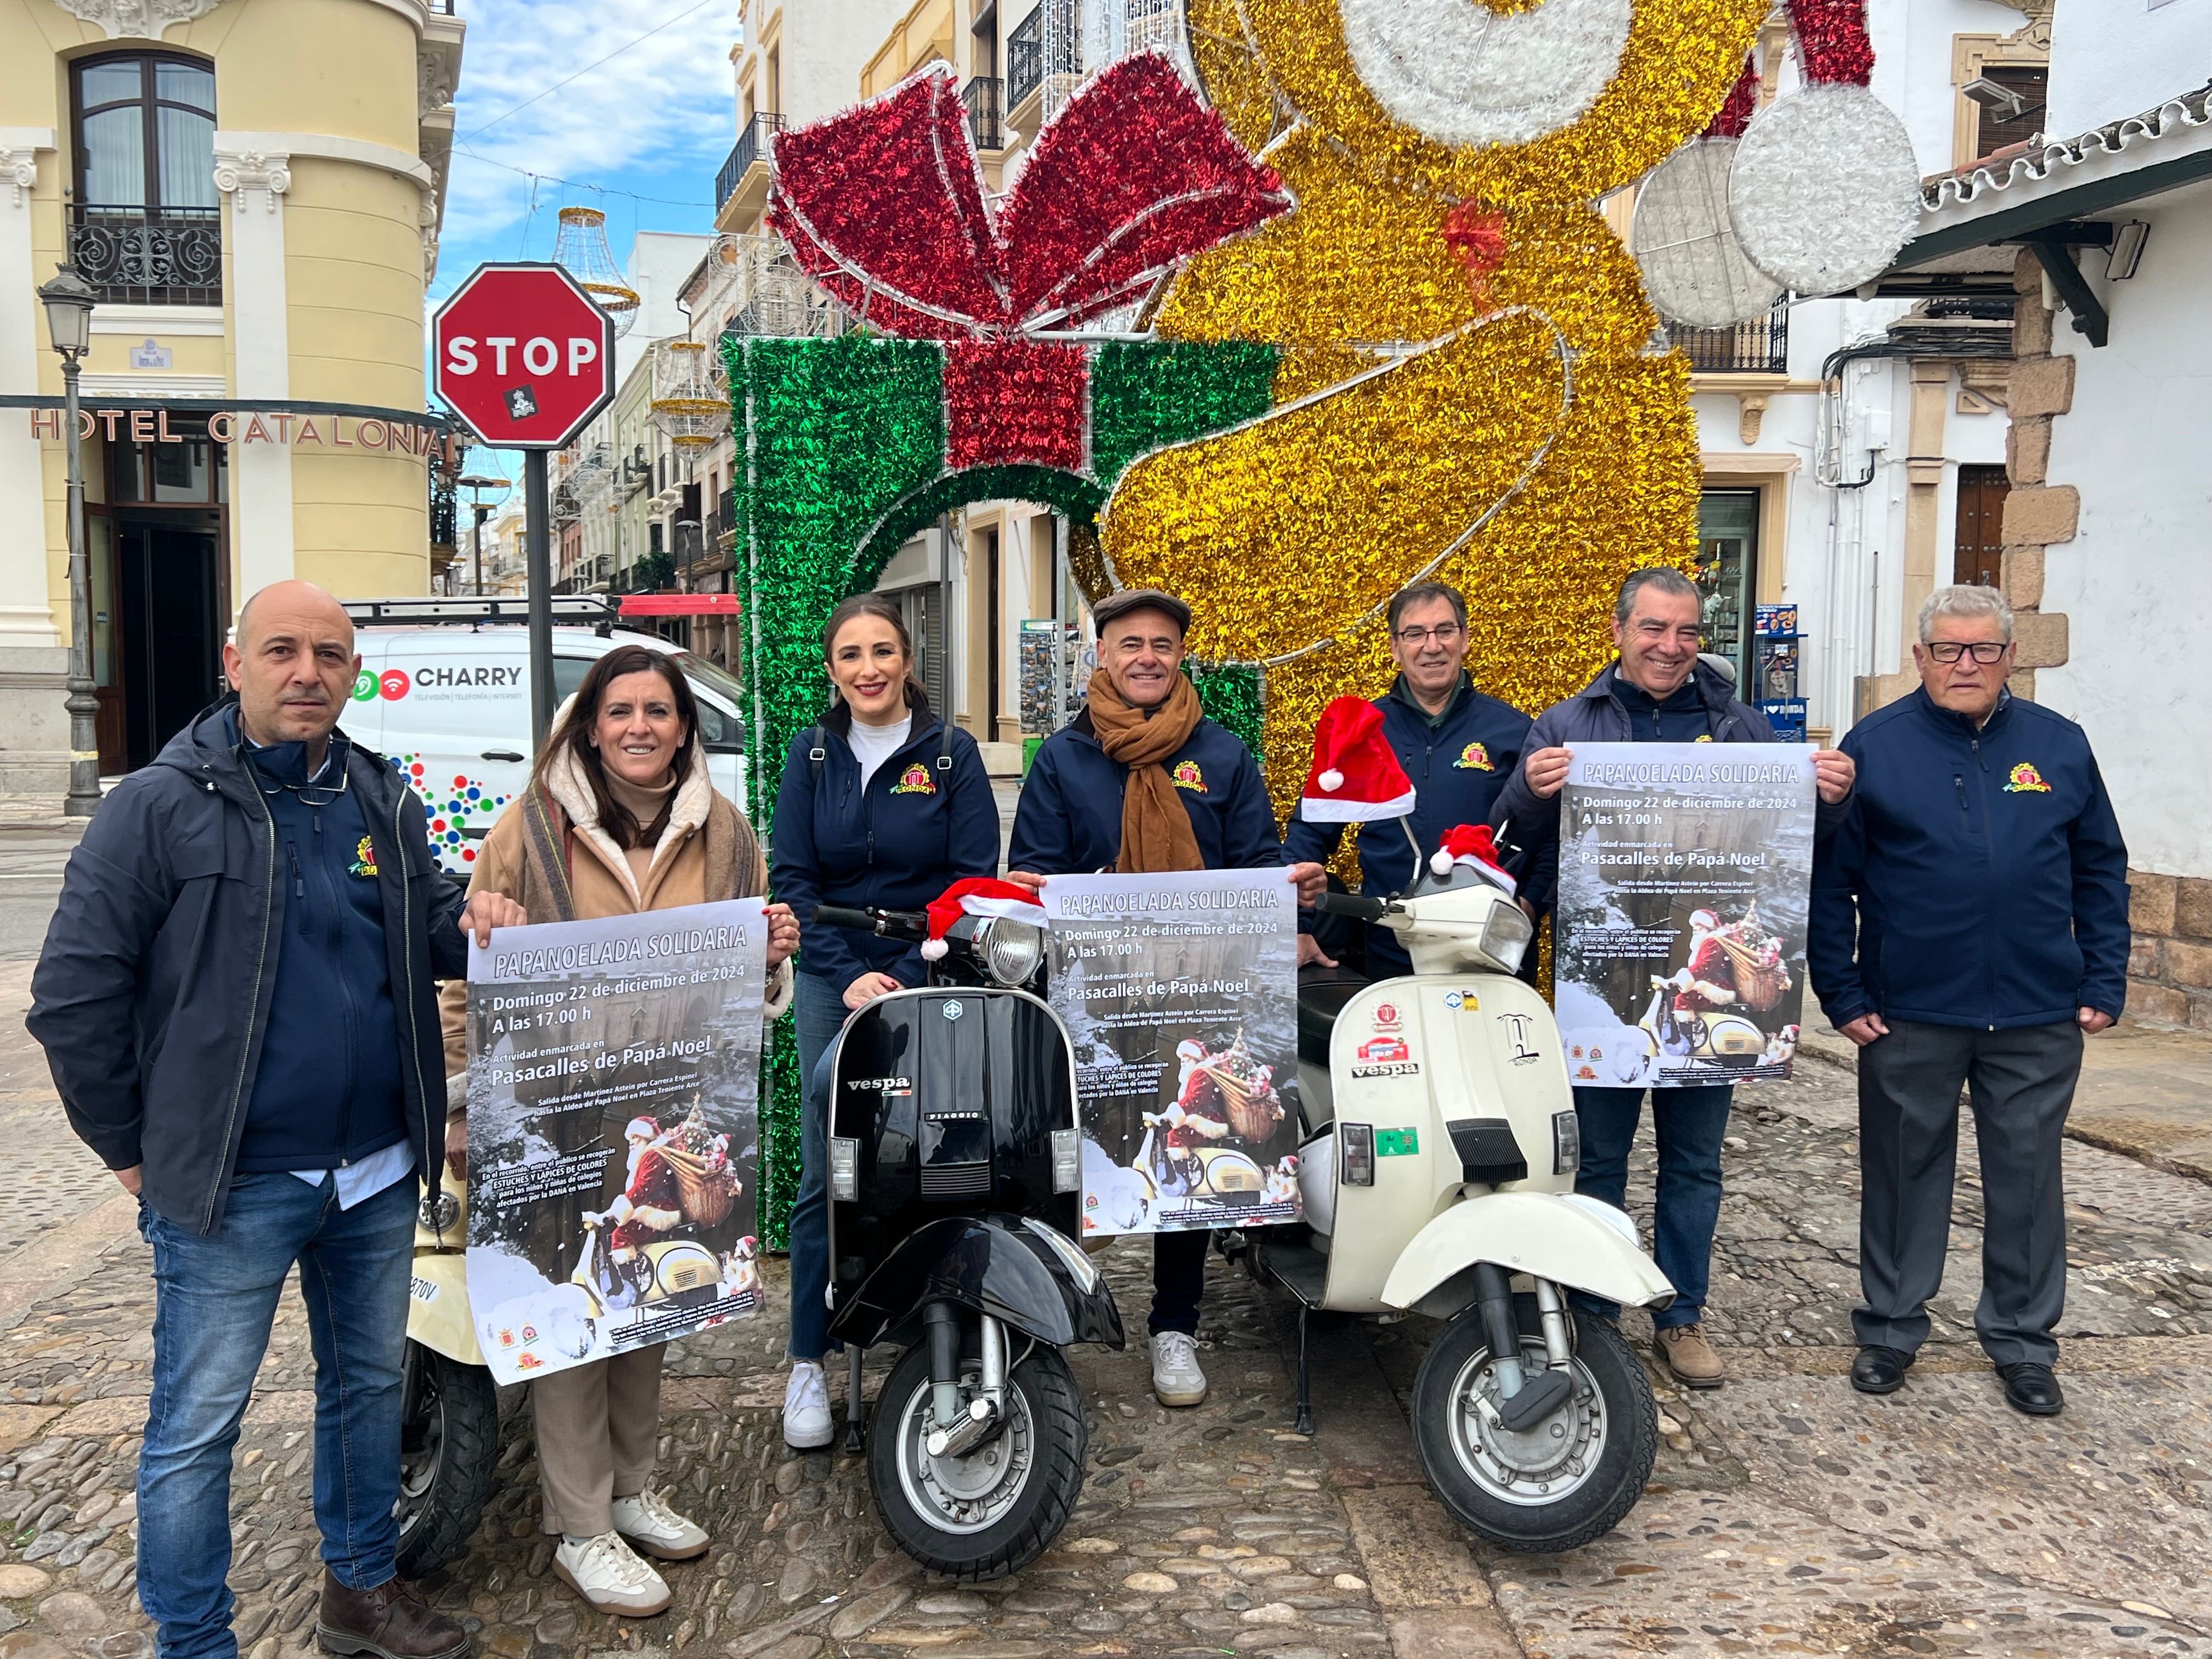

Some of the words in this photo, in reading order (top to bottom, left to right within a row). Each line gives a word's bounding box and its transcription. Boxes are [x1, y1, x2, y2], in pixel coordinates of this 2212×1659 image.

[446, 336, 597, 376] STOP
[30, 408, 183, 443] HOTEL
[208, 411, 444, 459] CATALONIA
[415, 667, 522, 686] CHARRY
[414, 693, 450, 701] TELEVISIÓN
[1779, 705, 1804, 714] RONDA
[1583, 764, 1705, 782] PAPANOELADA
[1709, 764, 1799, 783] SOLIDARIA
[1583, 796, 1640, 810] Domingo
[1644, 797, 1658, 808] 22
[1663, 797, 1678, 808] de
[1681, 796, 1743, 808] diciembre
[1747, 797, 1763, 808] de
[1766, 798, 1797, 809] 2024
[1582, 814, 1592, 824] A
[1595, 812, 1612, 824] las
[1617, 814, 1650, 825] 17.00
[1655, 812, 1662, 824] h
[1581, 851, 1660, 865] Pasacalles
[1664, 851, 1683, 865] de
[1688, 851, 1724, 868] Papá
[1730, 852, 1765, 865] Noel
[1060, 891, 1184, 915] PAPANOELADA
[1188, 888, 1279, 910] SOLIDARIA
[1065, 928, 1120, 941] Domingo
[1123, 926, 1137, 937] 22
[1142, 924, 1156, 936] de
[1161, 921, 1223, 936] diciembre
[1227, 922, 1243, 934] de
[1246, 922, 1278, 934] 2024
[495, 938, 642, 978] PAPANOELADA
[647, 925, 747, 958] SOLIDARIA
[1067, 947, 1076, 958] A
[1079, 945, 1096, 957] las
[1099, 944, 1132, 956] 17.00
[1135, 942, 1142, 953] h
[1068, 973, 1103, 983] Actividad
[1103, 970, 1144, 980] enmarcada
[493, 991, 565, 1011] Domingo
[569, 985, 586, 1000] 22
[592, 982, 610, 997] de
[614, 970, 686, 994] diciembre
[690, 969, 708, 983] de
[712, 964, 744, 980] 2024
[1066, 982, 1144, 1001] Pasacalles
[1147, 980, 1165, 995] de
[1171, 978, 1207, 997] Papá
[1214, 978, 1248, 993] Noel
[492, 1019, 504, 1034] A
[509, 1016, 531, 1031] las
[536, 1008, 577, 1026] 17.00
[582, 1005, 590, 1020] h
[492, 1048, 537, 1064] Actividad
[540, 1039, 590, 1056] enmarcada
[490, 1054, 589, 1088] Pasacalles
[594, 1050, 617, 1069] de
[623, 1042, 665, 1065] Papá
[672, 1035, 710, 1057] Noel
[1352, 1064, 1418, 1078] vespa
[1513, 1057, 1539, 1067] RONDA
[538, 1096, 560, 1106] Salida
[561, 1092, 582, 1102] desde
[583, 1088, 613, 1098] Martínez
[636, 1082, 648, 1090] por
[649, 1077, 673, 1086] Carrera
[674, 1071, 697, 1082] Espinel
[848, 1077, 910, 1091] vespa
[929, 1111, 979, 1120] PIAGGIO
[493, 1175, 529, 1189] ESTUCHES
[537, 1165, 565, 1180] LÁPICES
[566, 1165, 575, 1174] DE
[577, 1158, 607, 1171] COLORES
[410, 1276, 437, 1300] 870V
